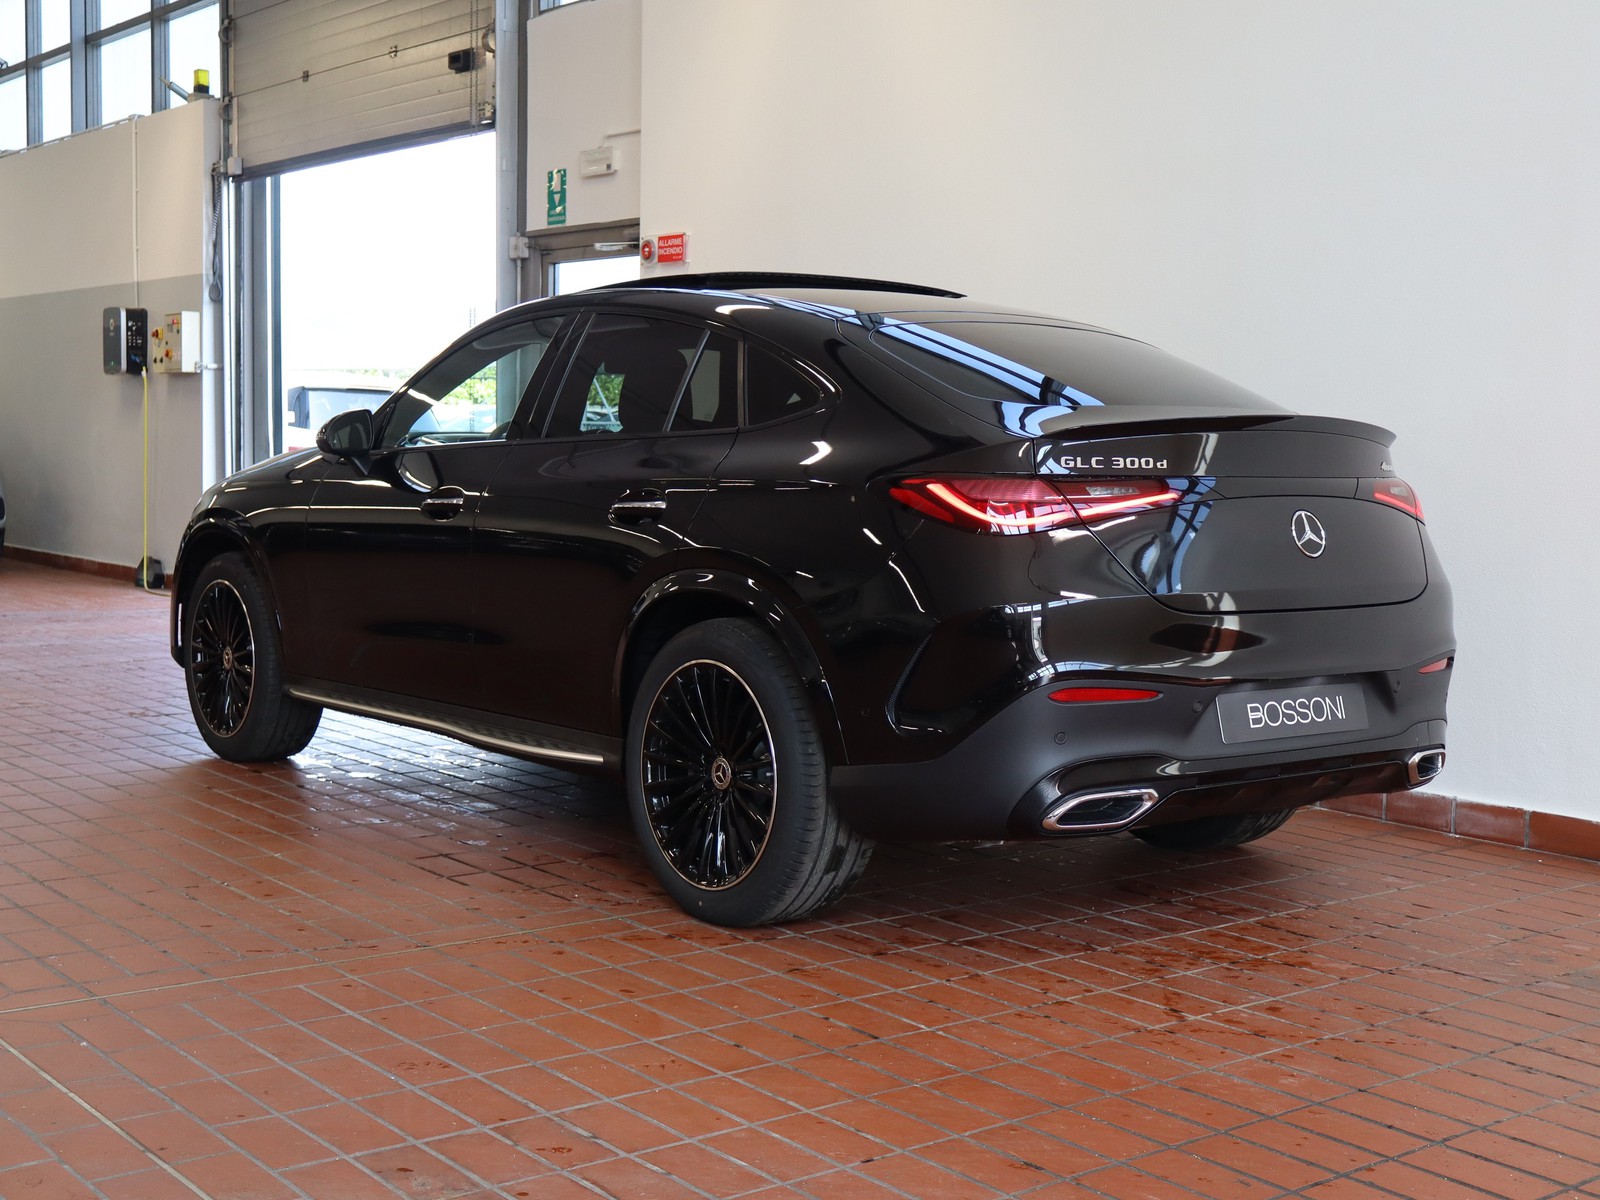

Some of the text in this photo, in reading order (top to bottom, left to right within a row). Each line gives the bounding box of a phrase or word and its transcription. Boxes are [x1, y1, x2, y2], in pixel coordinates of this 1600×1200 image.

[658, 237, 683, 247] ALLARME
[658, 246, 683, 256] INCENDIO
[1060, 456, 1105, 469] GLC
[1246, 695, 1346, 729] BOSSONI
